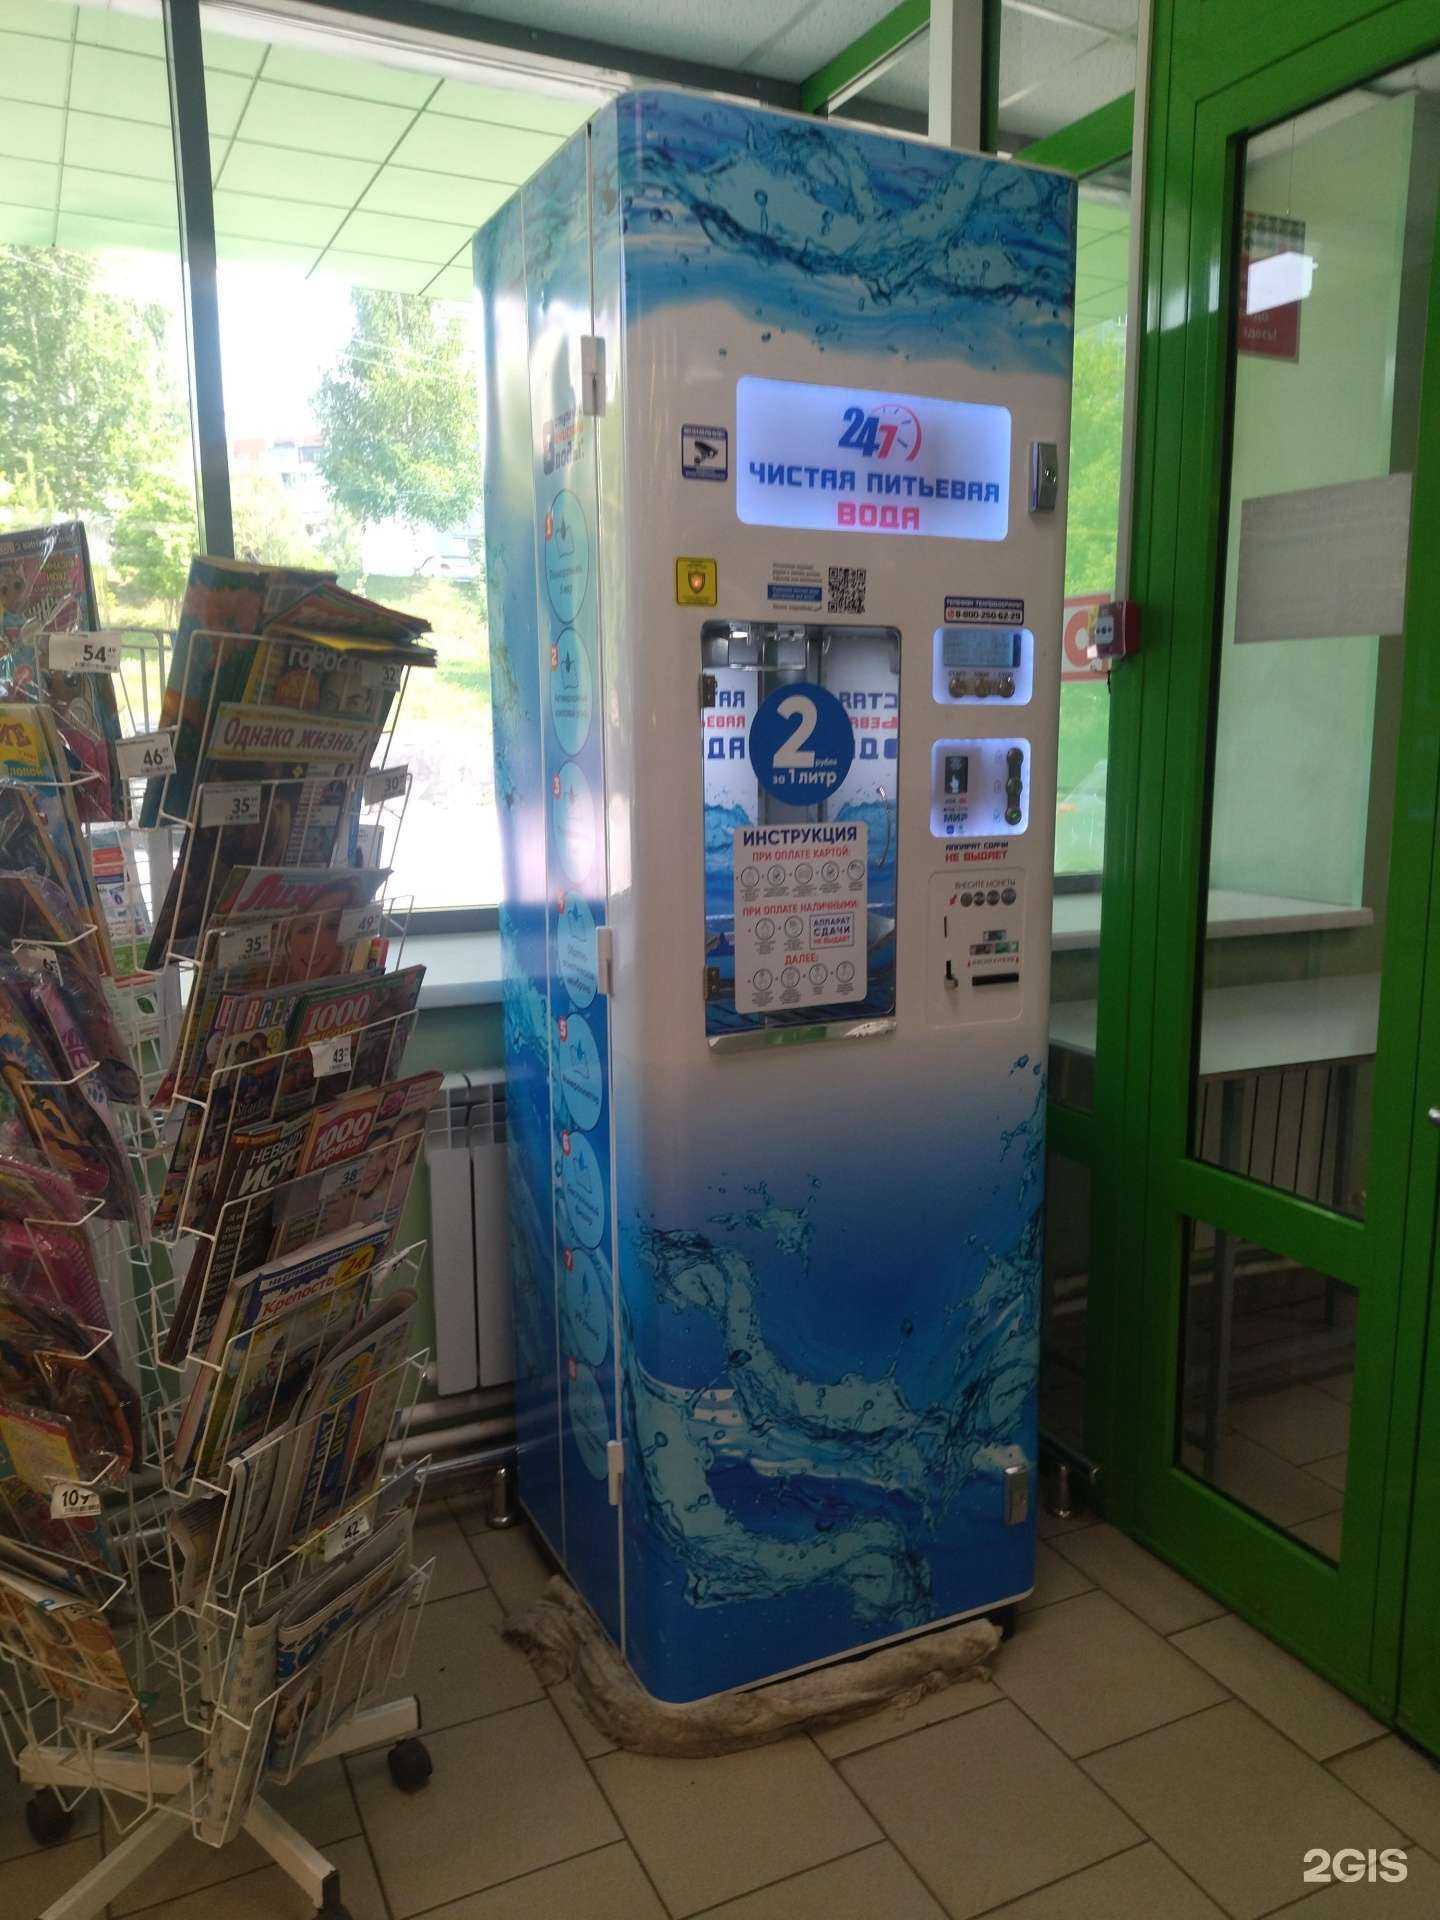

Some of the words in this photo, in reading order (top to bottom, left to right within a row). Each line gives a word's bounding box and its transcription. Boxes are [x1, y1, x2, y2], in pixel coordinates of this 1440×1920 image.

[749, 462, 856, 491] ЧИСТАЯ
[867, 472, 1000, 503] ПИТЬЕВАЯ
[837, 501, 920, 530] ВОДА
[83, 645, 106, 663] 54
[223, 716, 294, 750] Однако
[773, 694, 817, 769] 2
[143, 750, 163, 766] 46
[772, 775, 786, 785] за
[788, 768, 796, 785] 1
[798, 770, 838, 789] литр
[232, 798, 250, 815] 35
[743, 826, 857, 847] ИНСТРУКЦИЯ
[752, 851, 772, 862] ПРИ
[774, 848, 810, 860] ОПЛАТЕ
[945, 854, 960, 863] НЕ
[742, 906, 761, 917] ПРИ
[763, 904, 797, 915] ОПЛАТЕ
[813, 916, 850, 928] АППАРАТ
[813, 926, 850, 937] СДАЧИ
[246, 936, 262, 953] 35
[306, 994, 371, 1035] 1000
[332, 1047, 345, 1063] 43
[317, 1111, 373, 1152] 1000
[343, 1520, 360, 1539] 42
